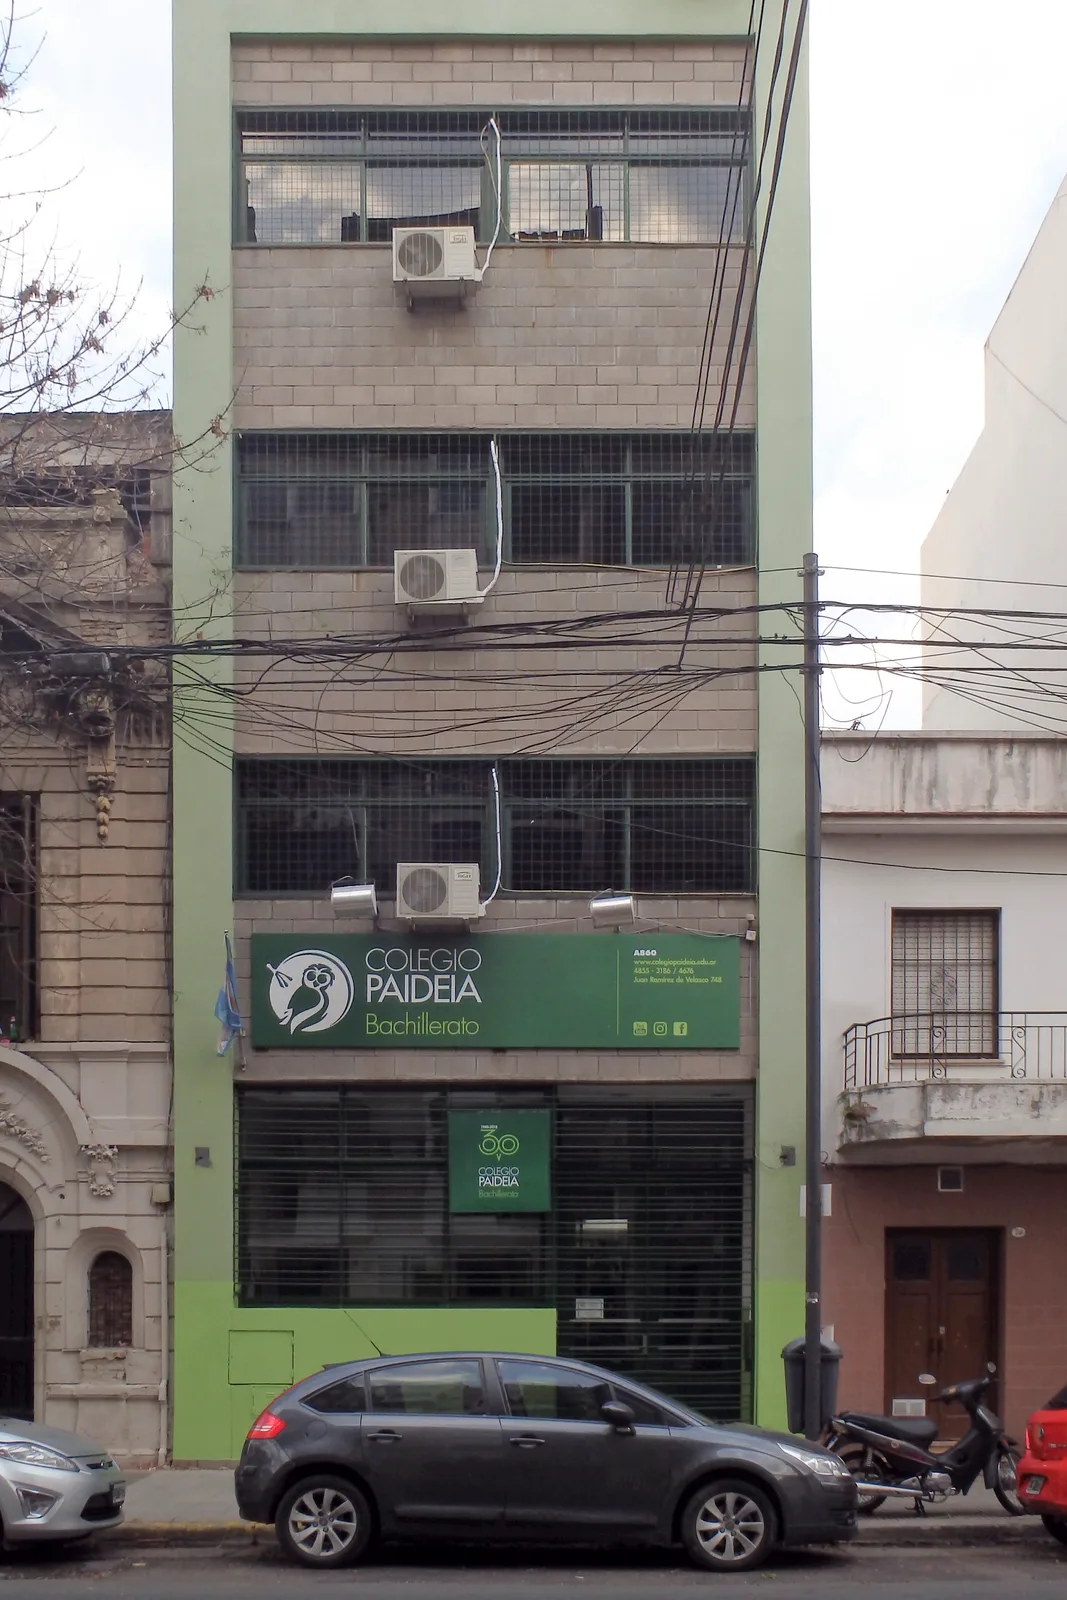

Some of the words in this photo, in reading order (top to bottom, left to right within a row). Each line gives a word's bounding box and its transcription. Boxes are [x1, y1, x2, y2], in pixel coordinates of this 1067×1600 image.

[365, 948, 482, 972] COLEGIO
[633, 958, 717, 967] www.colegiopaideia.edu.ar
[365, 974, 482, 1003] PAIDEIA
[365, 1012, 480, 1035] Bachillerato
[478, 1166, 520, 1176] COLEGIO
[478, 1176, 520, 1187] PAIDEIA
[478, 1189, 519, 1198] Bachillerato
